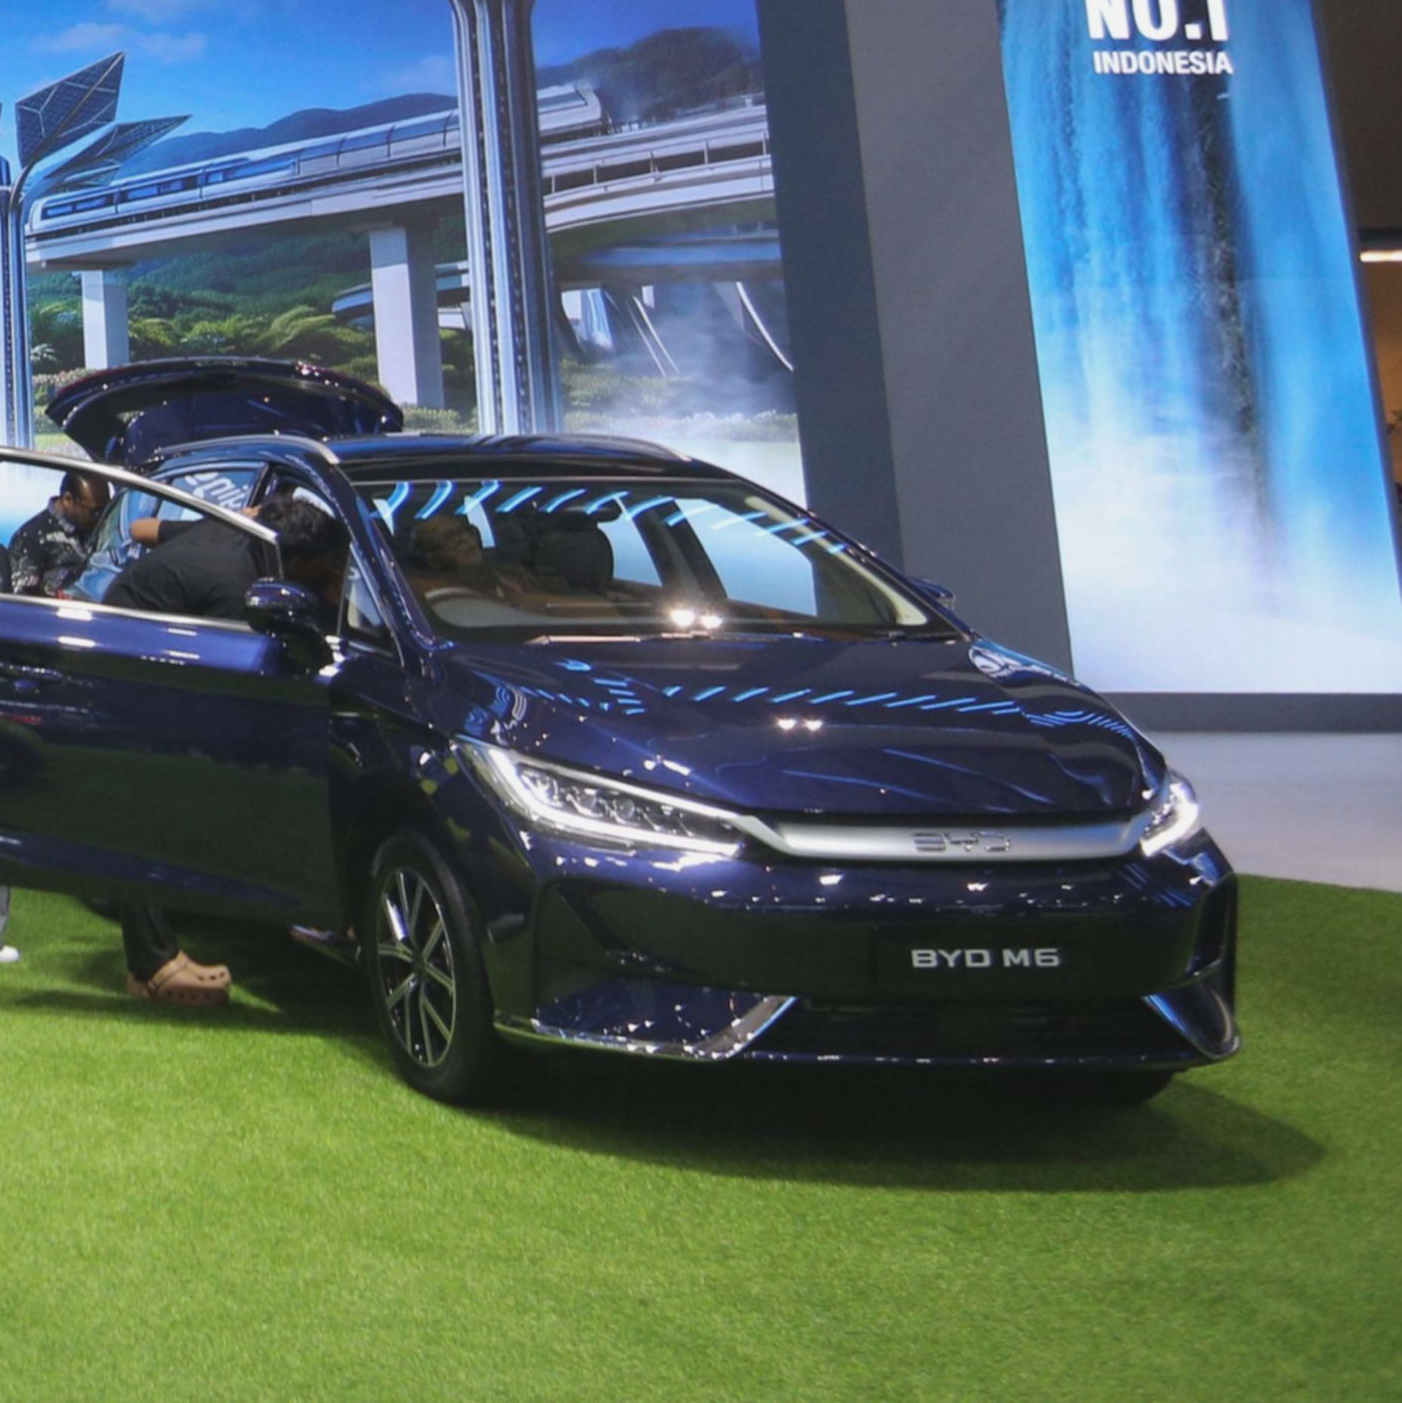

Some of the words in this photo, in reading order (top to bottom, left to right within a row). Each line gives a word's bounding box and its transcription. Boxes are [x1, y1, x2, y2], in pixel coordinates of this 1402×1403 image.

[1093, 50, 1234, 75] INDONESIA
[911, 949, 991, 968] BYD
[1002, 948, 1061, 967] M6
